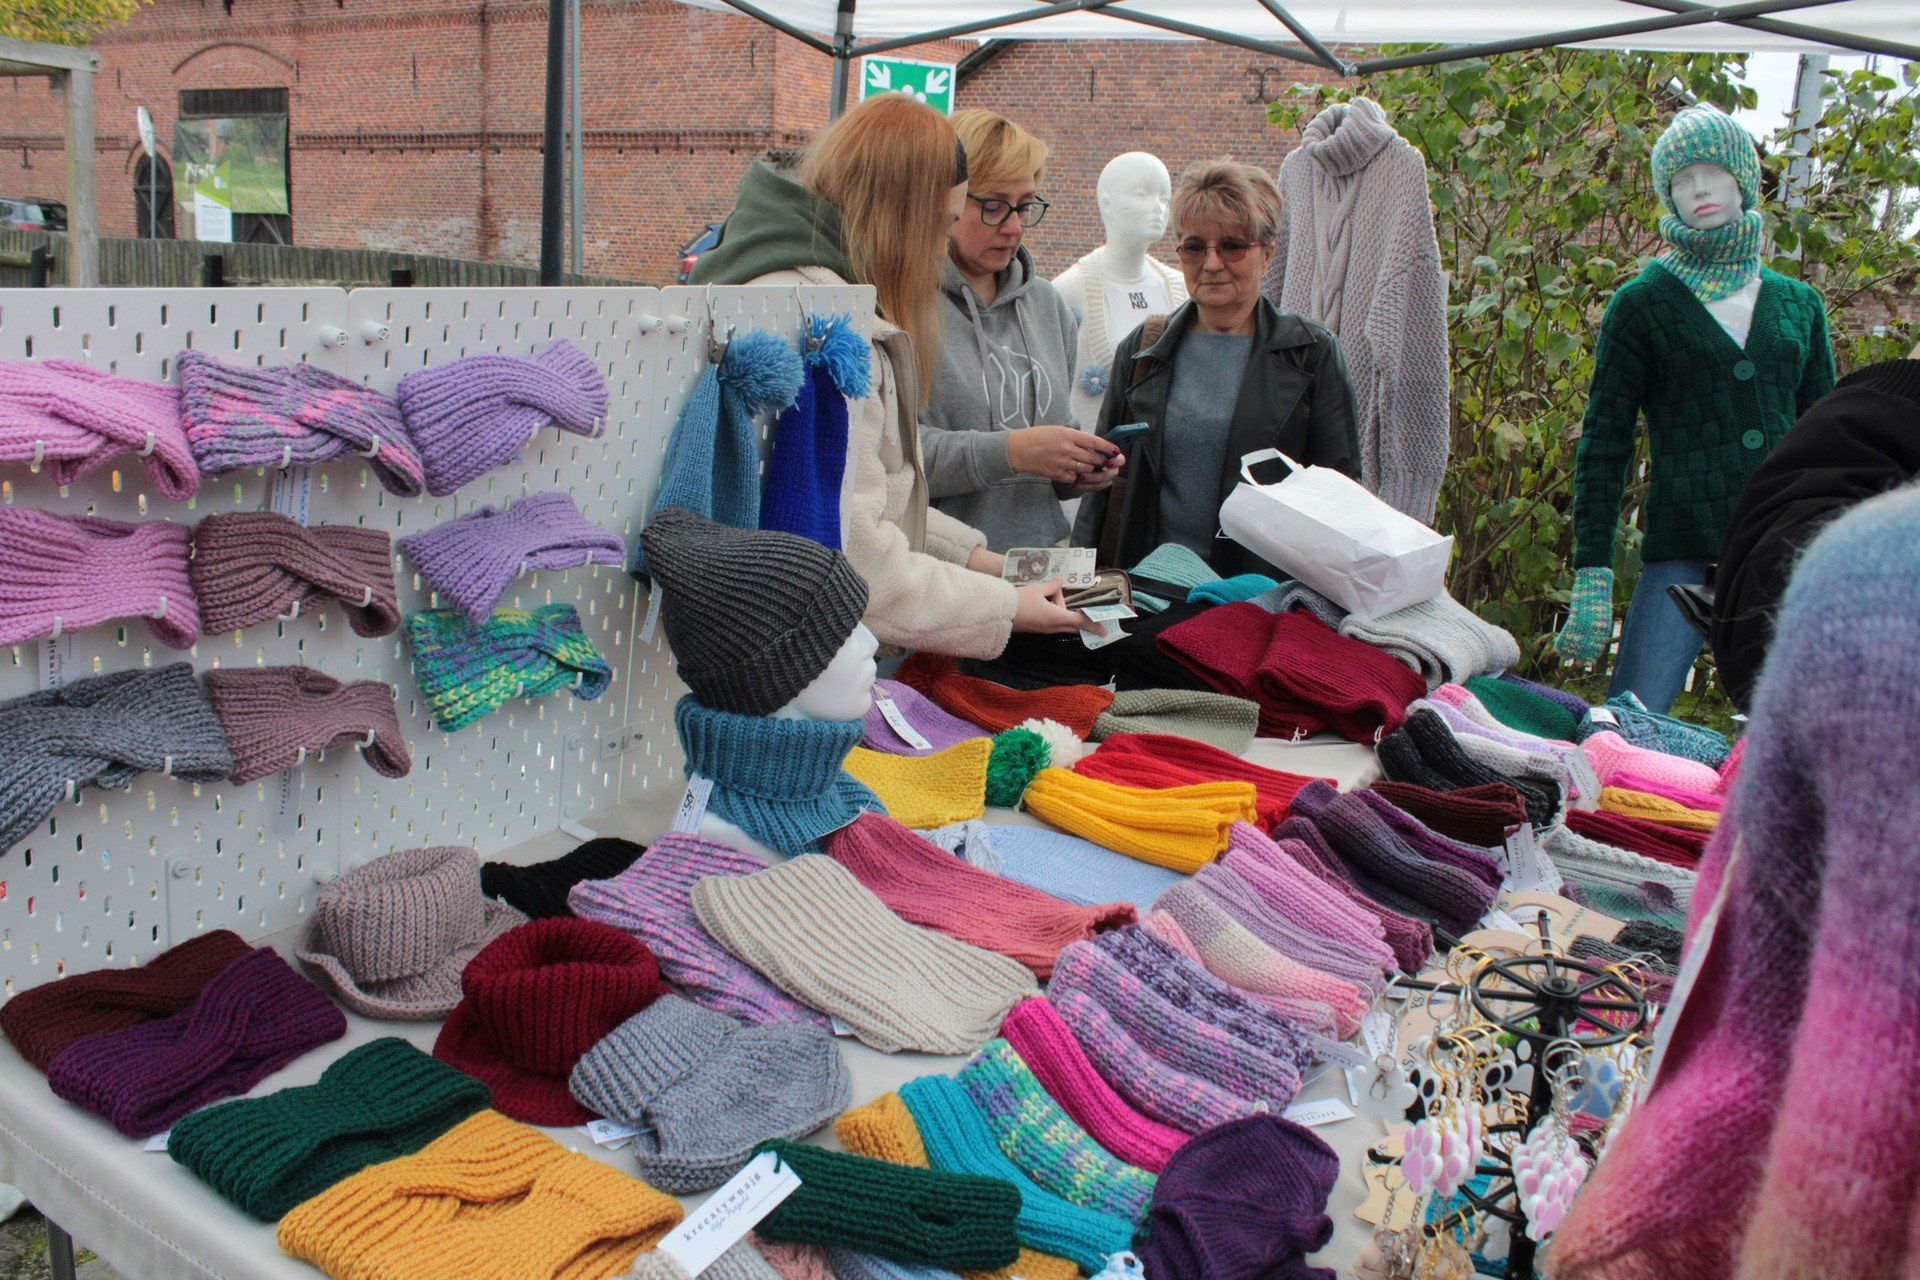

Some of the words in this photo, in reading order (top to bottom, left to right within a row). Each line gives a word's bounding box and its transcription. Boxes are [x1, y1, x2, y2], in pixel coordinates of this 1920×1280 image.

[1128, 292, 1145, 302] MI
[1131, 300, 1148, 309] ND
[1081, 571, 1092, 584] 10
